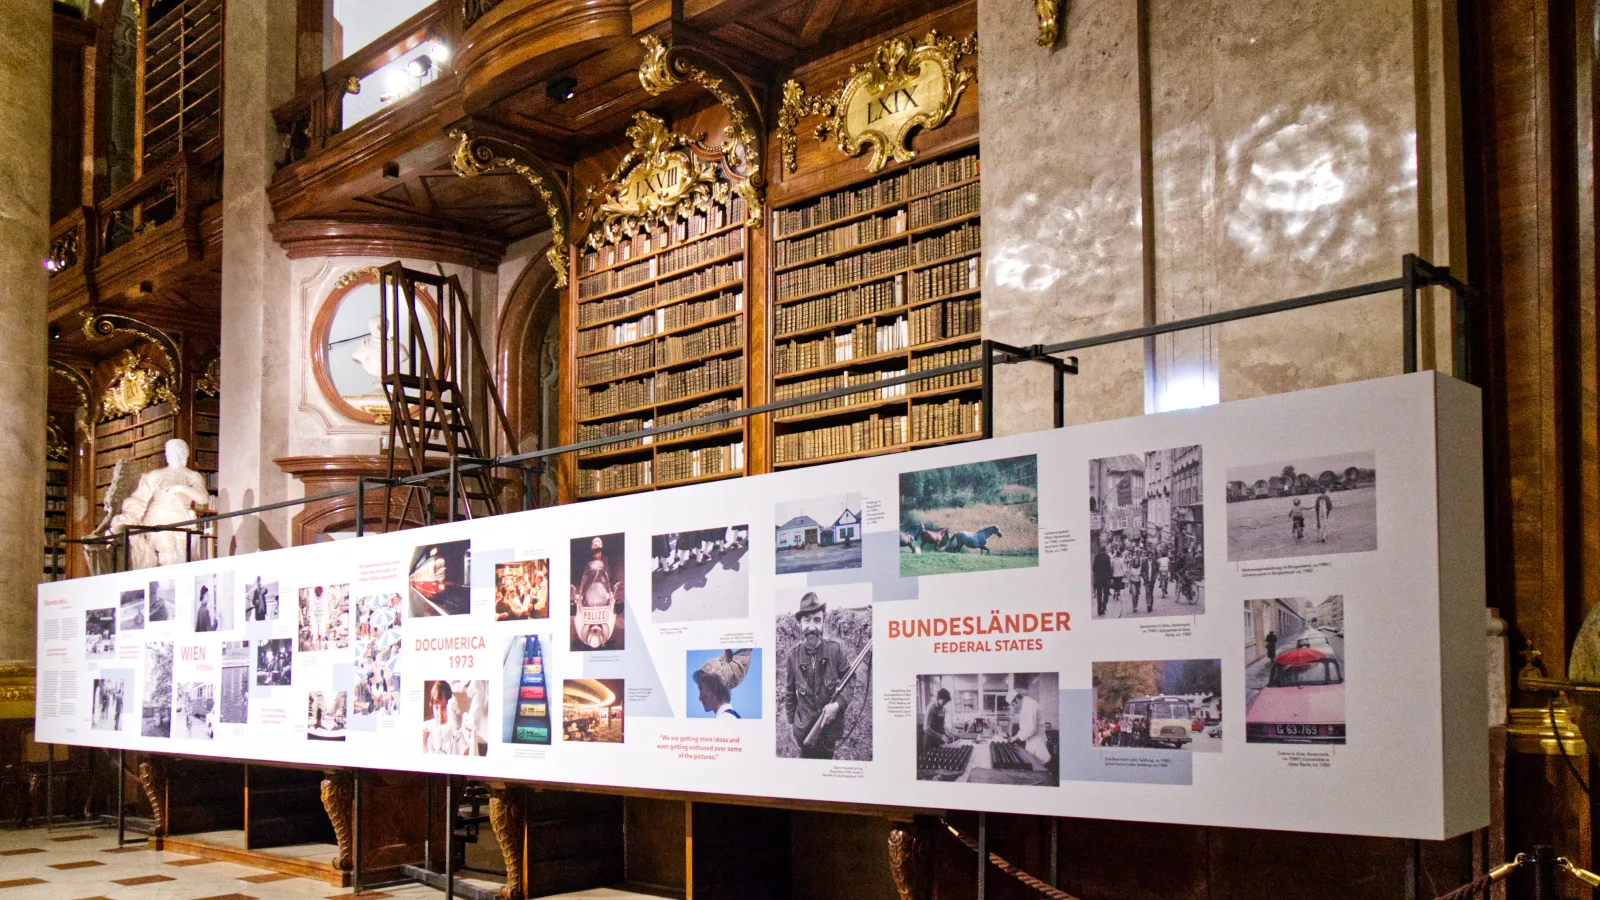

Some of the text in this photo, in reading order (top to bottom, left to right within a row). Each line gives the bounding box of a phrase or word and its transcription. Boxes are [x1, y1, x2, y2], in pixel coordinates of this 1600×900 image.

[867, 84, 920, 124] LXIX
[636, 166, 678, 199] LXVIII
[888, 610, 1071, 639] BUNDESLÄNDER
[415, 636, 486, 652] DOCUMERICA
[934, 638, 1043, 654] FEDERAL STATES
[181, 645, 206, 661] WIEN
[449, 655, 474, 669] 1973
[1276, 724, 1284, 735] G
